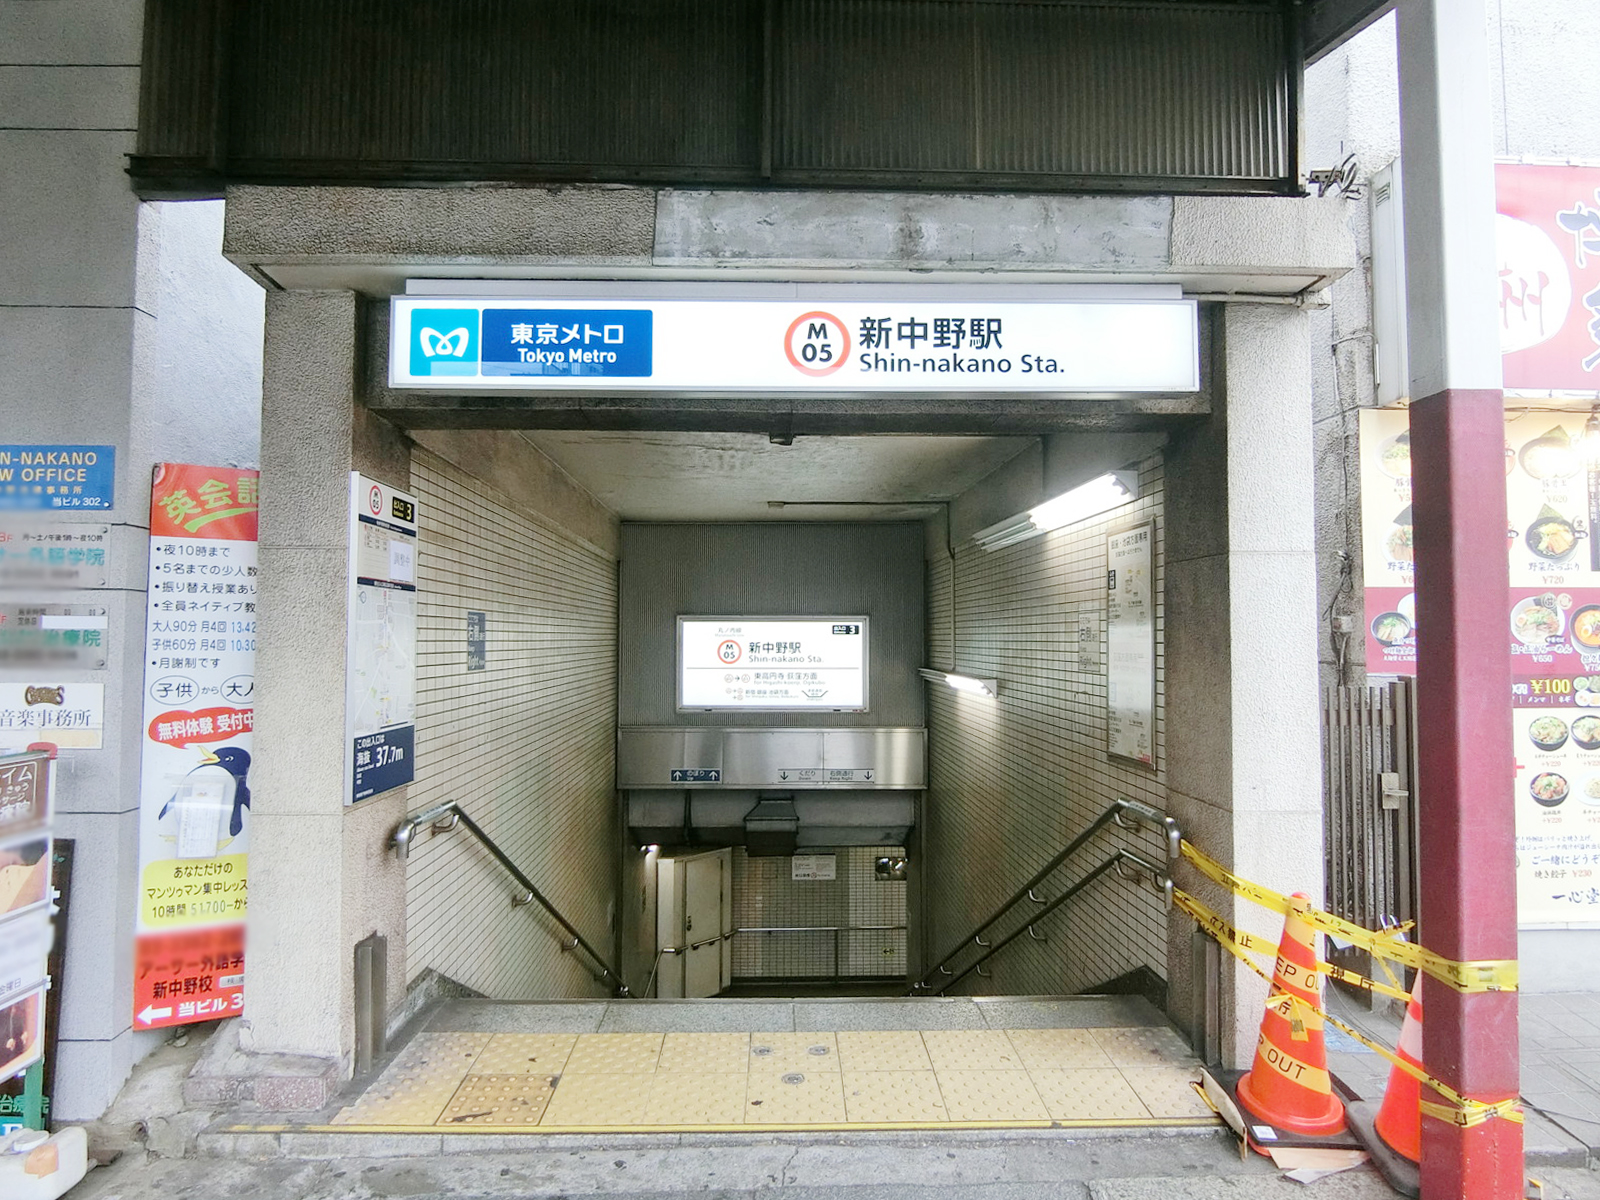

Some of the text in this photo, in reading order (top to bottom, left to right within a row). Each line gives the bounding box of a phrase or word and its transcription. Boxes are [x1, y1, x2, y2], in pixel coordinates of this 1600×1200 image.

[510, 322, 625, 346] 東京メトロ
[807, 322, 828, 340] M
[859, 316, 1003, 350] 新中野駅
[517, 347, 617, 366] Tokyo Metro
[801, 342, 833, 363] 05
[859, 352, 1065, 373] Shin-nakano Sta.
[21, 467, 88, 483] OFFICE
[82, 497, 101, 508] 302
[405, 503, 412, 521] 3
[163, 543, 231, 558] 夜10時まで
[162, 562, 257, 578] 5名までの少人数
[1528, 561, 1580, 572] 野菜たっぷり
[1542, 575, 1565, 584] ¥720
[152, 620, 198, 633] 大人90分
[200, 620, 227, 634] 月4回
[849, 625, 856, 635] 3
[152, 638, 197, 651] 子供60分
[200, 639, 227, 651] 月4回
[749, 641, 802, 654] 新中野駅
[158, 657, 221, 669] 月謝制です
[723, 651, 736, 659] 05
[748, 655, 824, 663] Shin-nakano Sta.
[156, 682, 193, 698] 子供
[201, 686, 220, 695] から
[1530, 678, 1571, 695] ¥100
[158, 711, 254, 741] 無料体験 受付中
[375, 745, 404, 768] 37.7m
[174, 862, 233, 880] あなただけの
[152, 975, 213, 1000] 新中野校
[178, 998, 228, 1017] 当ビル
[1266, 1047, 1307, 1080] OUT
